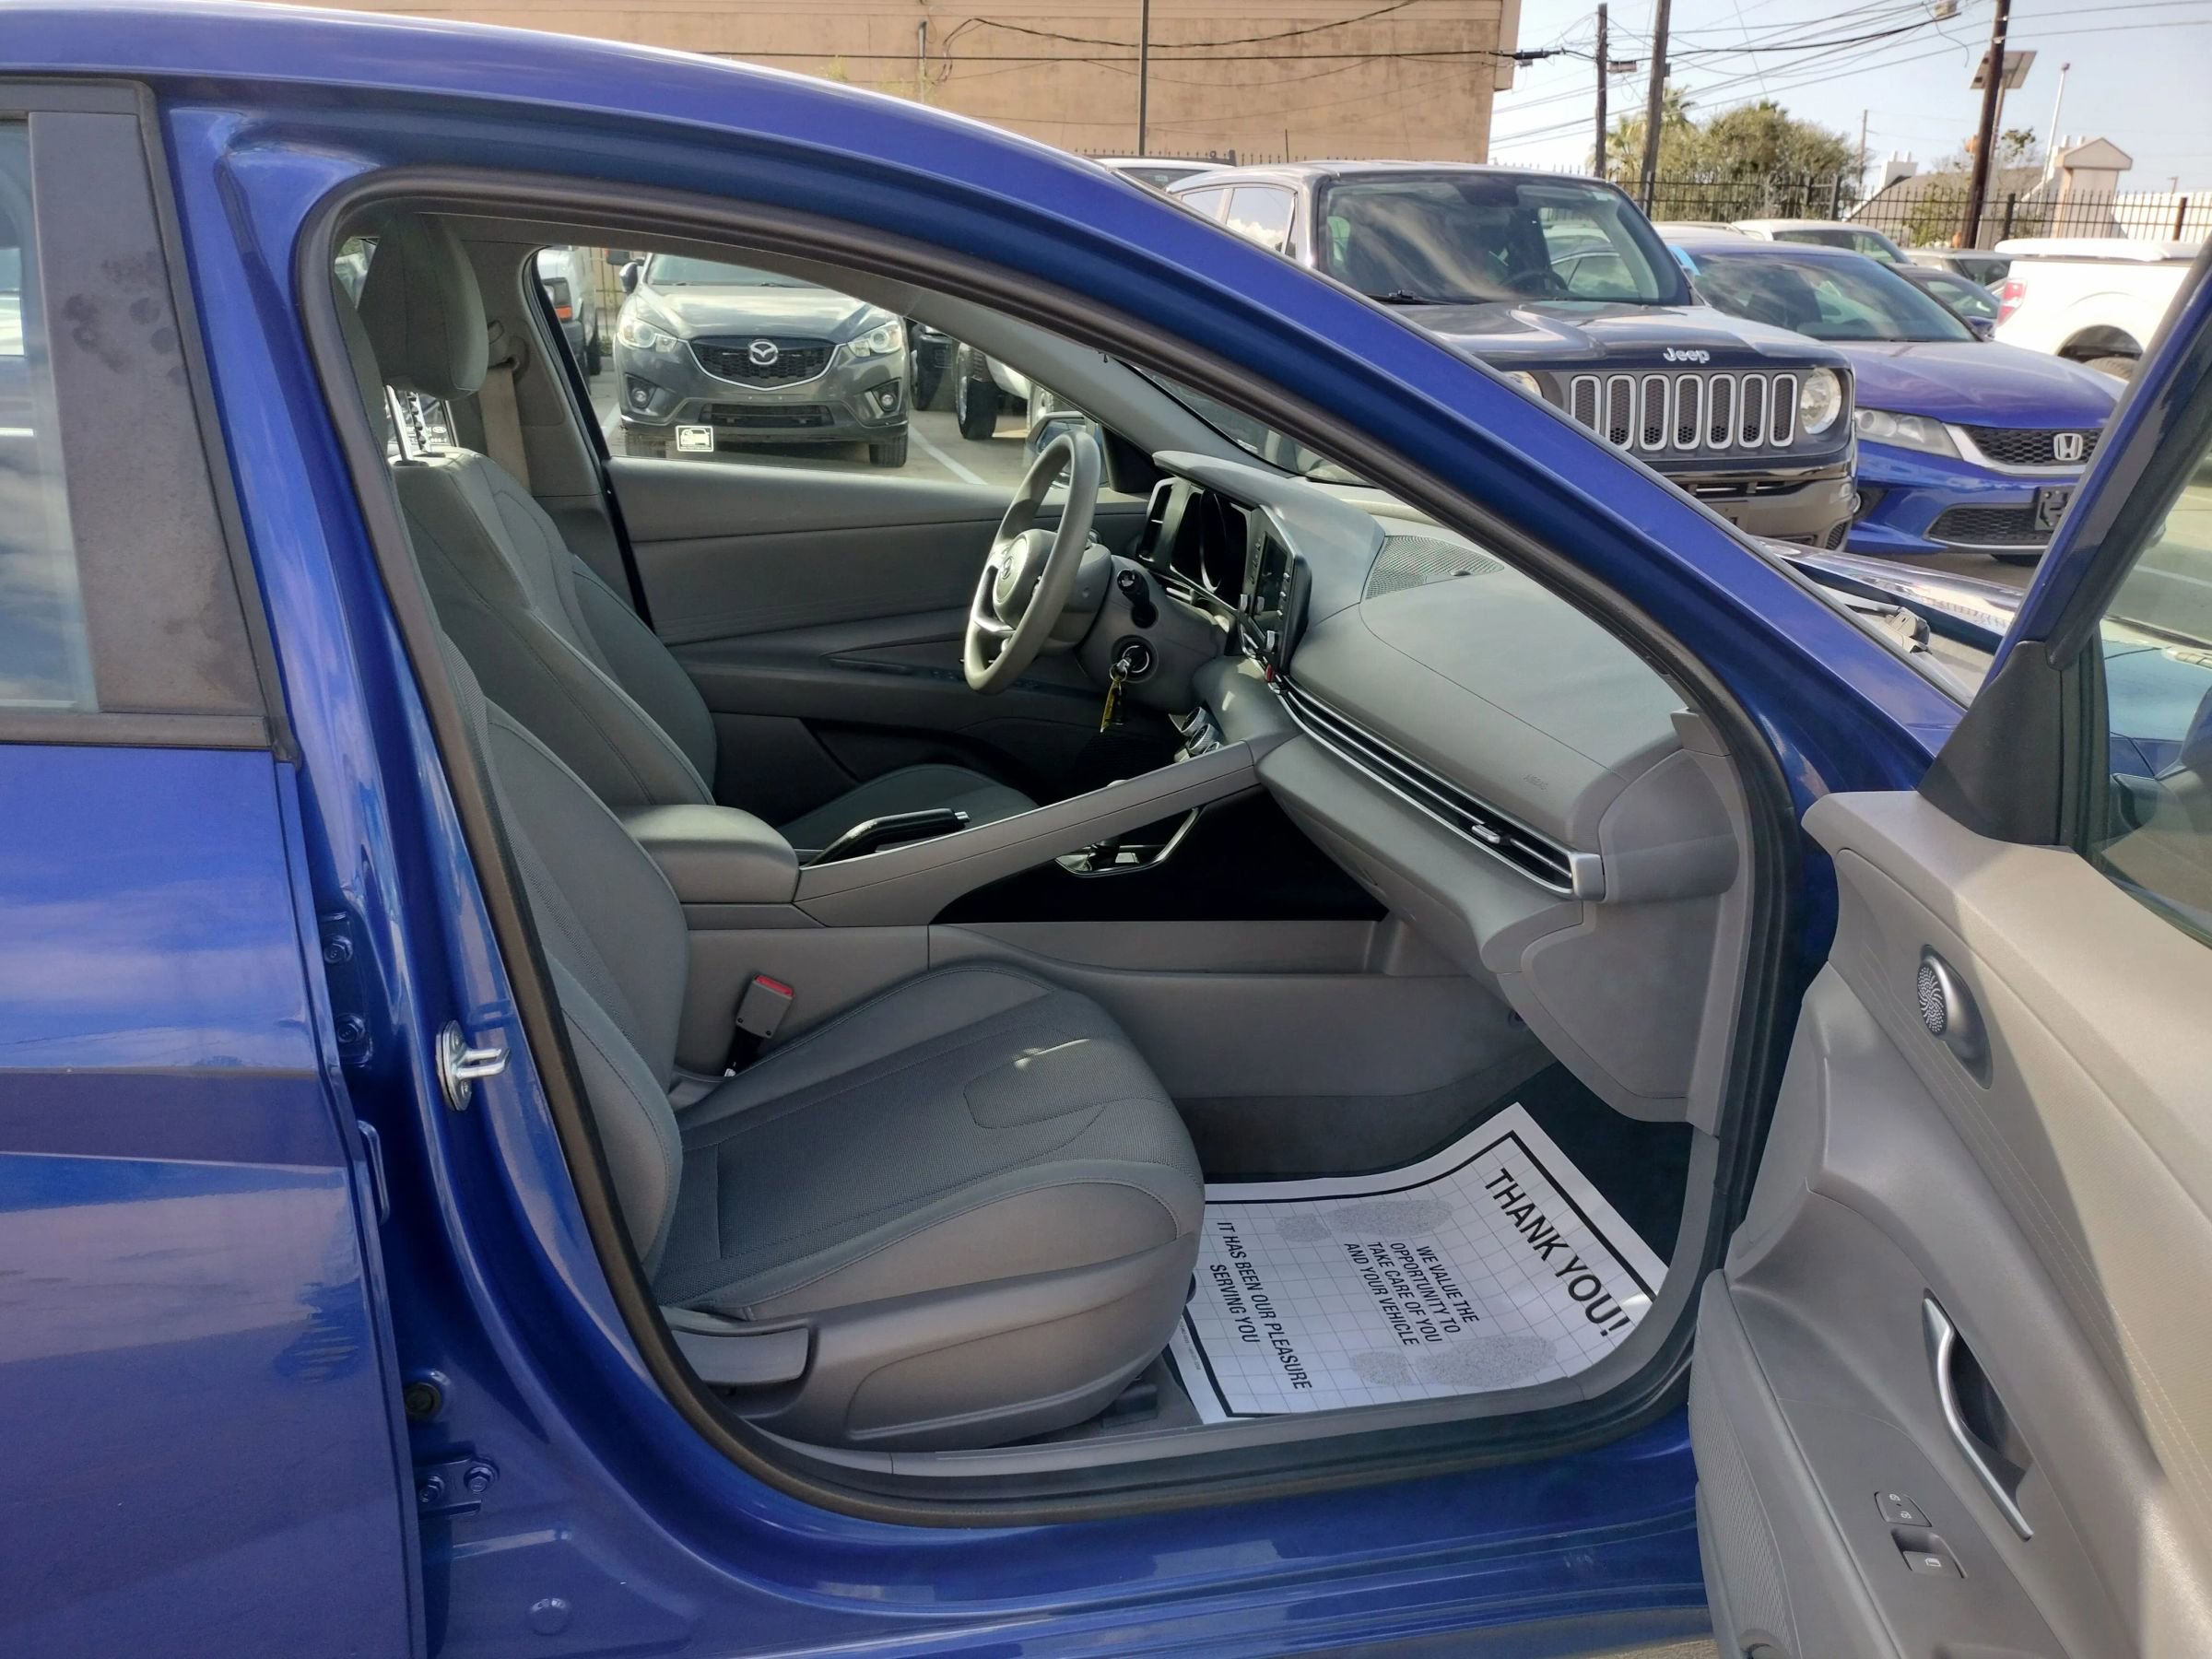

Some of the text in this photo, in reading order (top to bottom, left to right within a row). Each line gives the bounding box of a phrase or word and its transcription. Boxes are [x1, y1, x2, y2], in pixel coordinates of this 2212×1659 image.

[1663, 347, 1711, 364] Jeep
[1343, 1242, 1420, 1346] AND YOUR VEHICLE
[1367, 1241, 1443, 1343] TAKE CARE OF YOU
[1390, 1242, 1461, 1334] OPPORTUNITY TO
[1416, 1245, 1480, 1324] WE VALUE THE
[1485, 1167, 1630, 1337] THANK YOU!
[1209, 1265, 1261, 1343] SERVING YOU
[1217, 1222, 1312, 1390] IT HAS BEEN OUR PLEASURE
